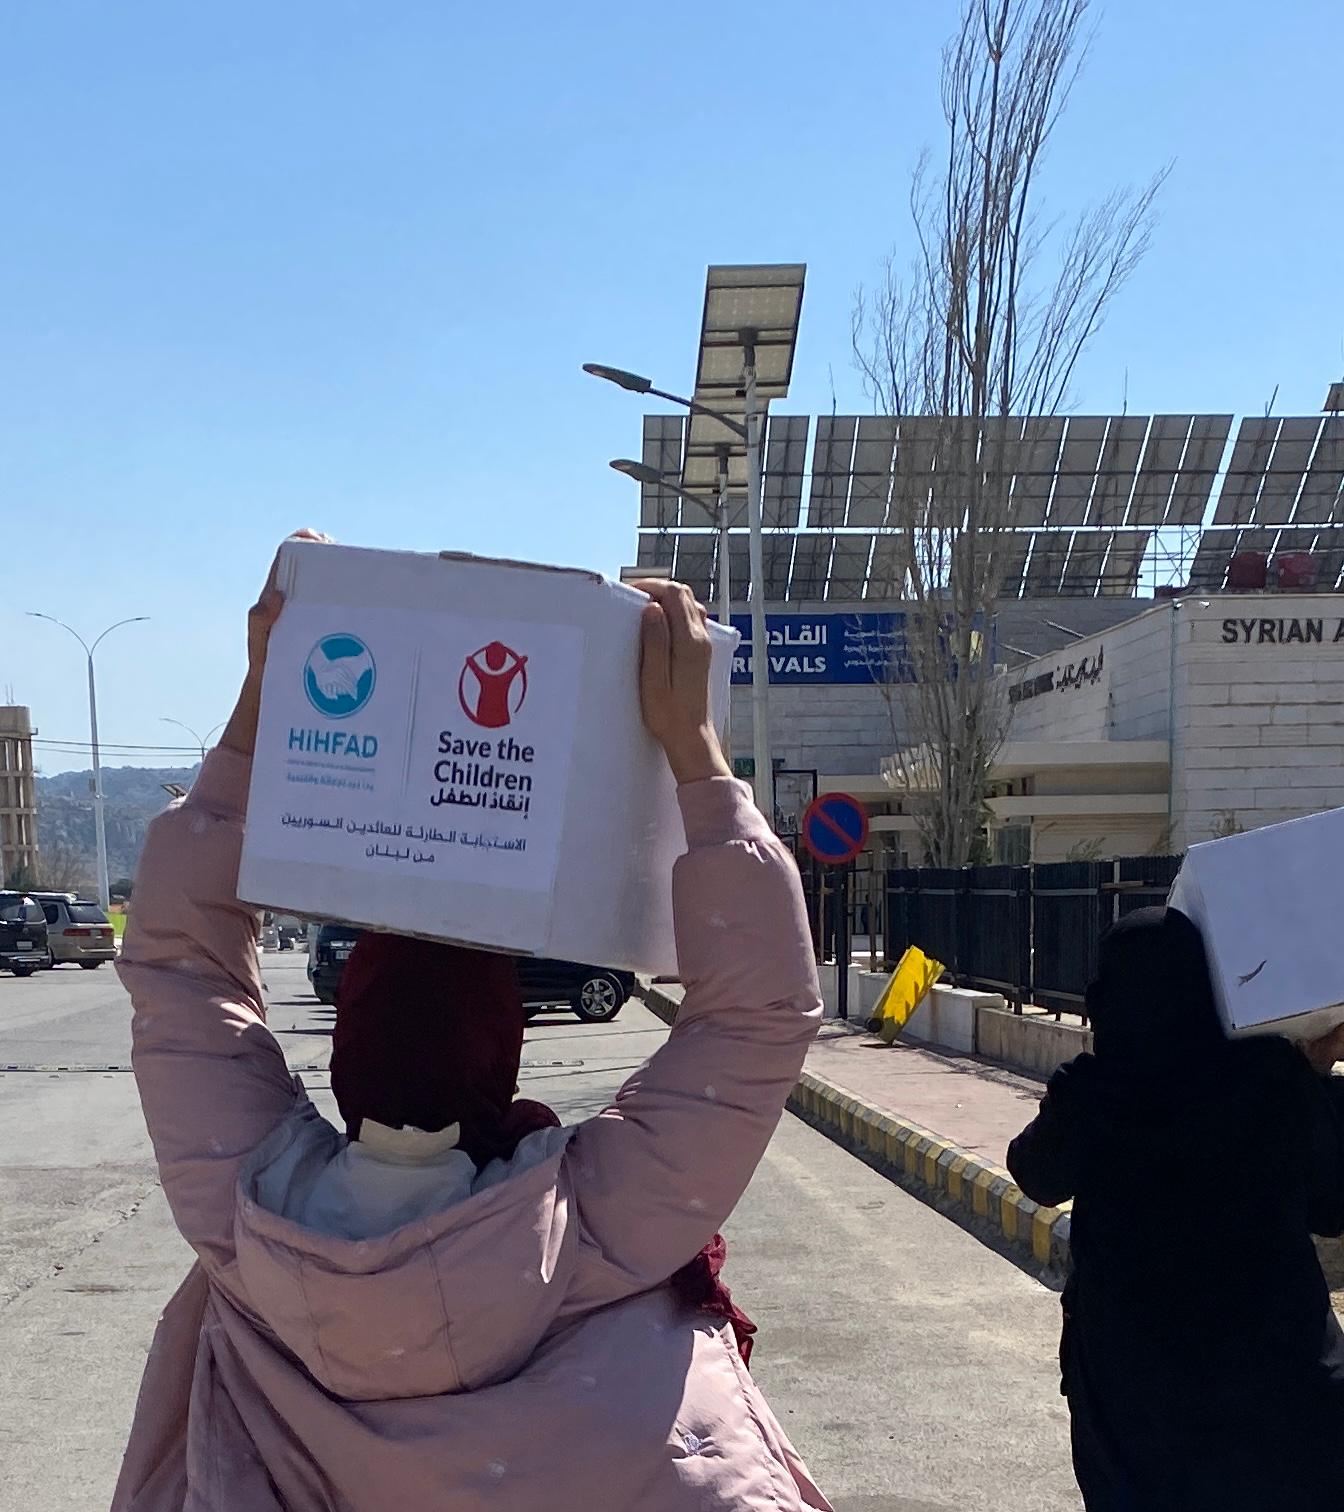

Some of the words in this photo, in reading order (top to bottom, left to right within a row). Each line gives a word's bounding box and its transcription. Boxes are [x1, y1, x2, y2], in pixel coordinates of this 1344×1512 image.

[1222, 617, 1323, 643] SYRIAN
[438, 730, 492, 758] Save
[497, 737, 535, 762] the
[434, 760, 533, 791] Children
[430, 787, 487, 807] الطفل
[489, 791, 531, 820] إنقاذ
[281, 812, 344, 829] السوريين
[365, 843, 410, 859] لبنان
[412, 851, 436, 863] من
